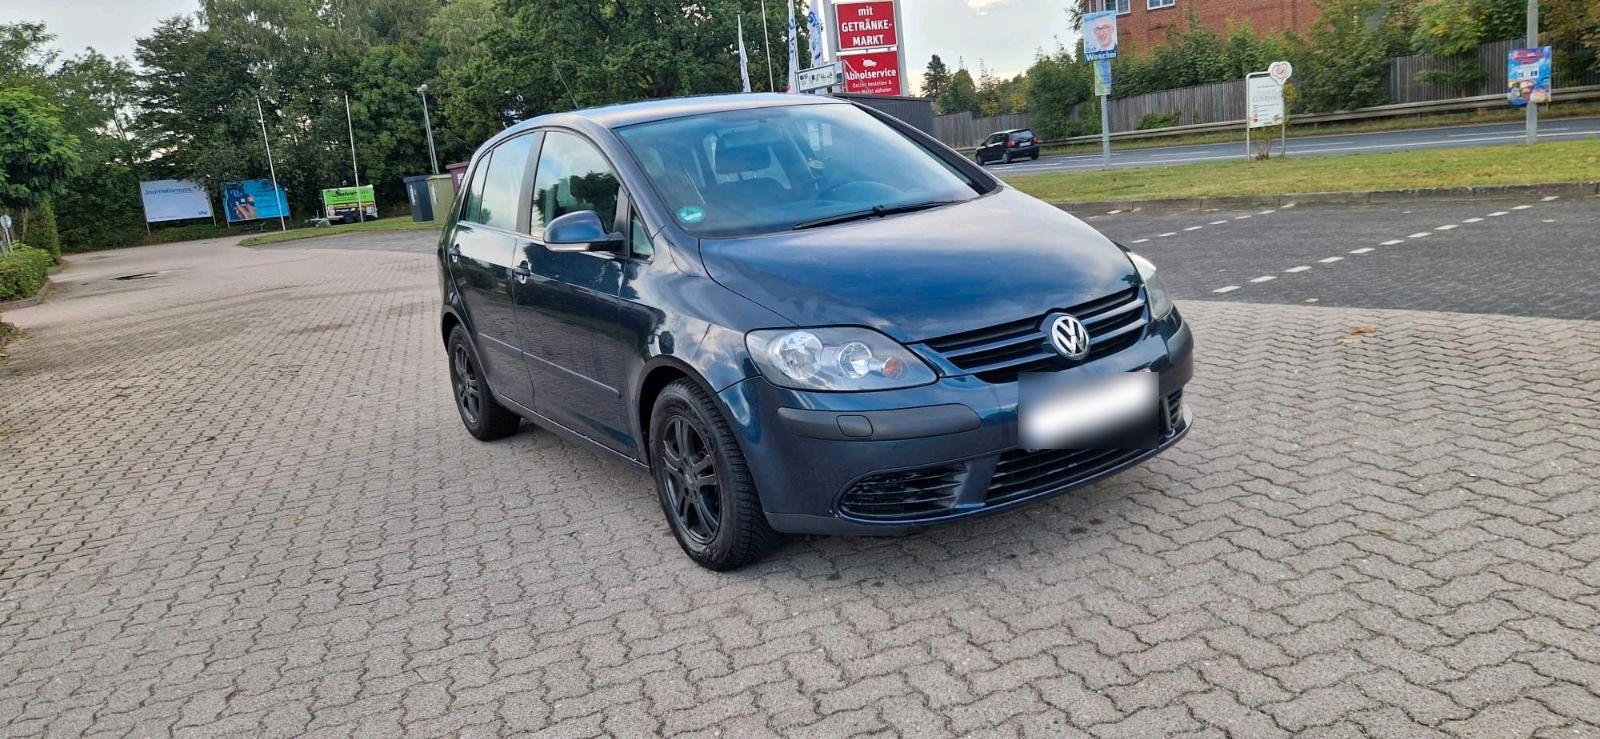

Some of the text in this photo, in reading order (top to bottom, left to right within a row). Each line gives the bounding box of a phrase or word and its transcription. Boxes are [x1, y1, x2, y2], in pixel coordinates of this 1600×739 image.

[858, 5, 873, 16] mit
[841, 19, 892, 32] GETRÄNKE-
[852, 34, 884, 46] MARKT
[1052, 315, 1089, 358] VW
